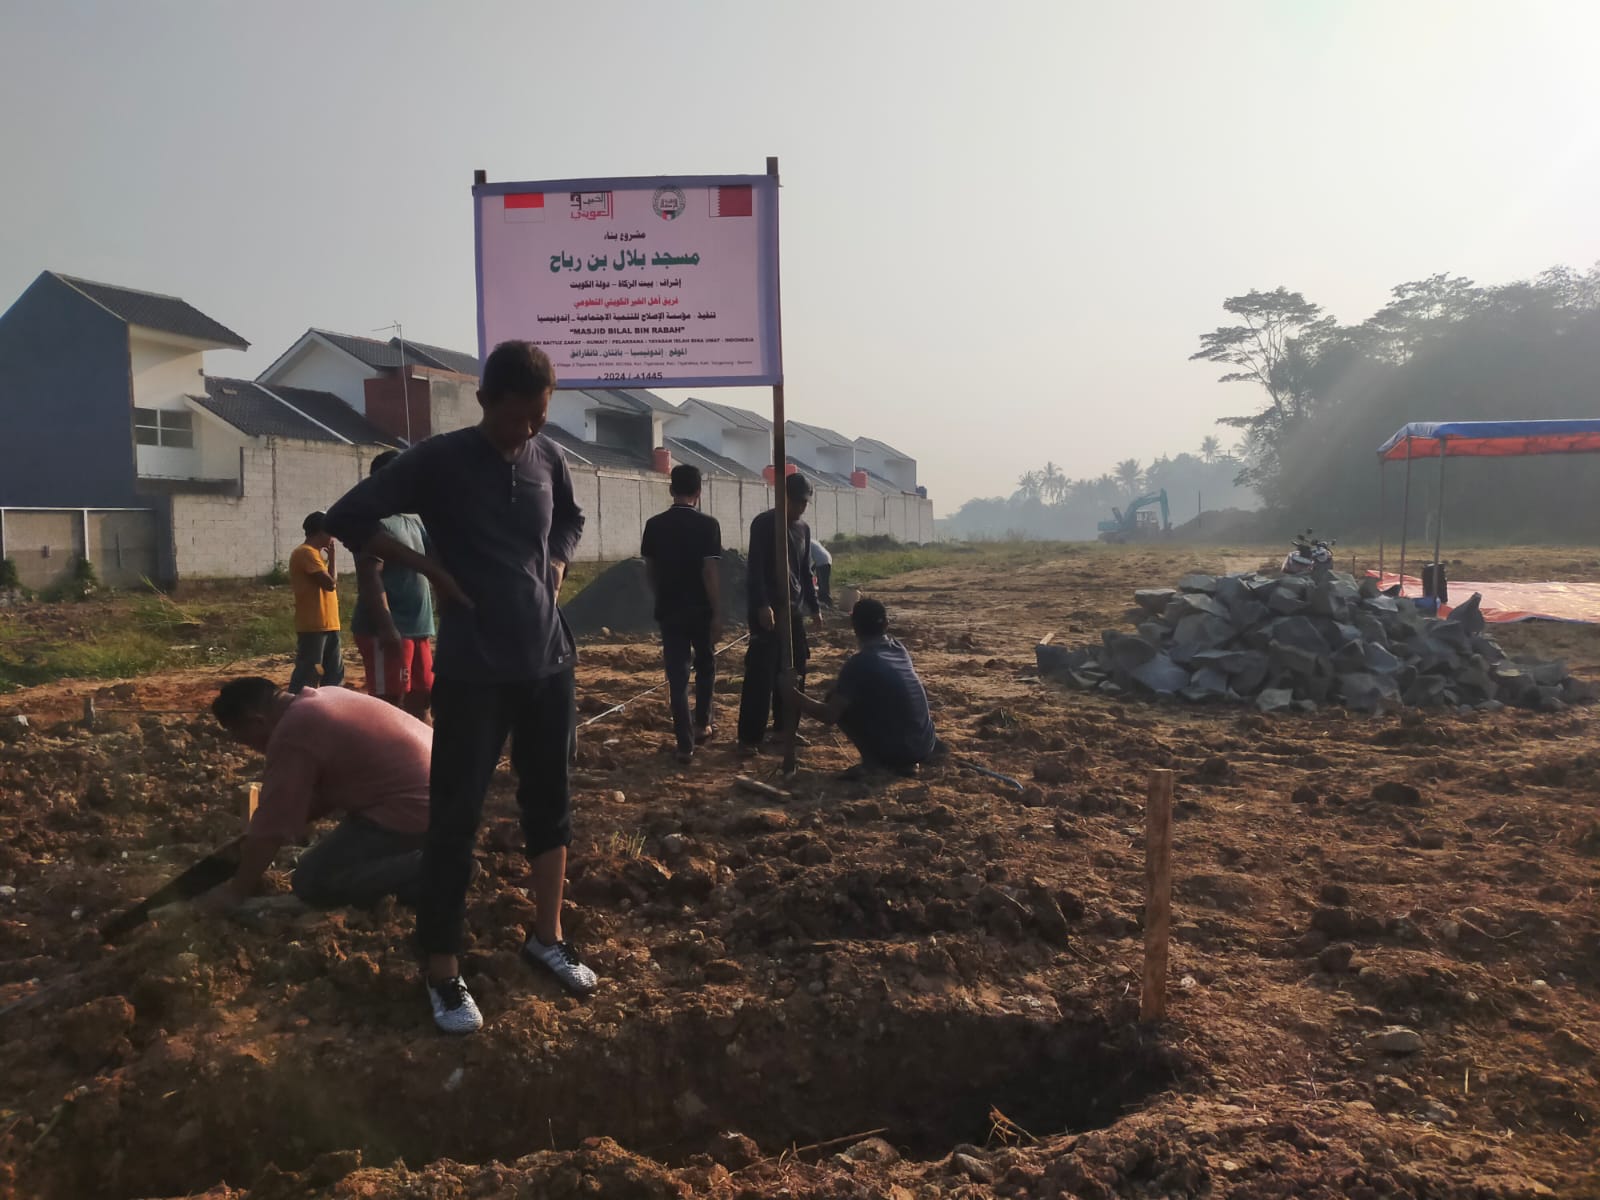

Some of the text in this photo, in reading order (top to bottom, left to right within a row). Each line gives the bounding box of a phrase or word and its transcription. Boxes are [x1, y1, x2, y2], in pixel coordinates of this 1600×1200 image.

[620, 231, 647, 242] مشروع
[549, 248, 701, 273] مسجد بلال بن رباح
[569, 279, 595, 290] الكويت
[595, 279, 611, 290] دولة
[618, 279, 638, 290] الزكاة
[638, 279, 654, 289] بيت
[608, 327, 633, 335] BILAL
[634, 327, 650, 335] BIN
[603, 372, 626, 381] 2024
